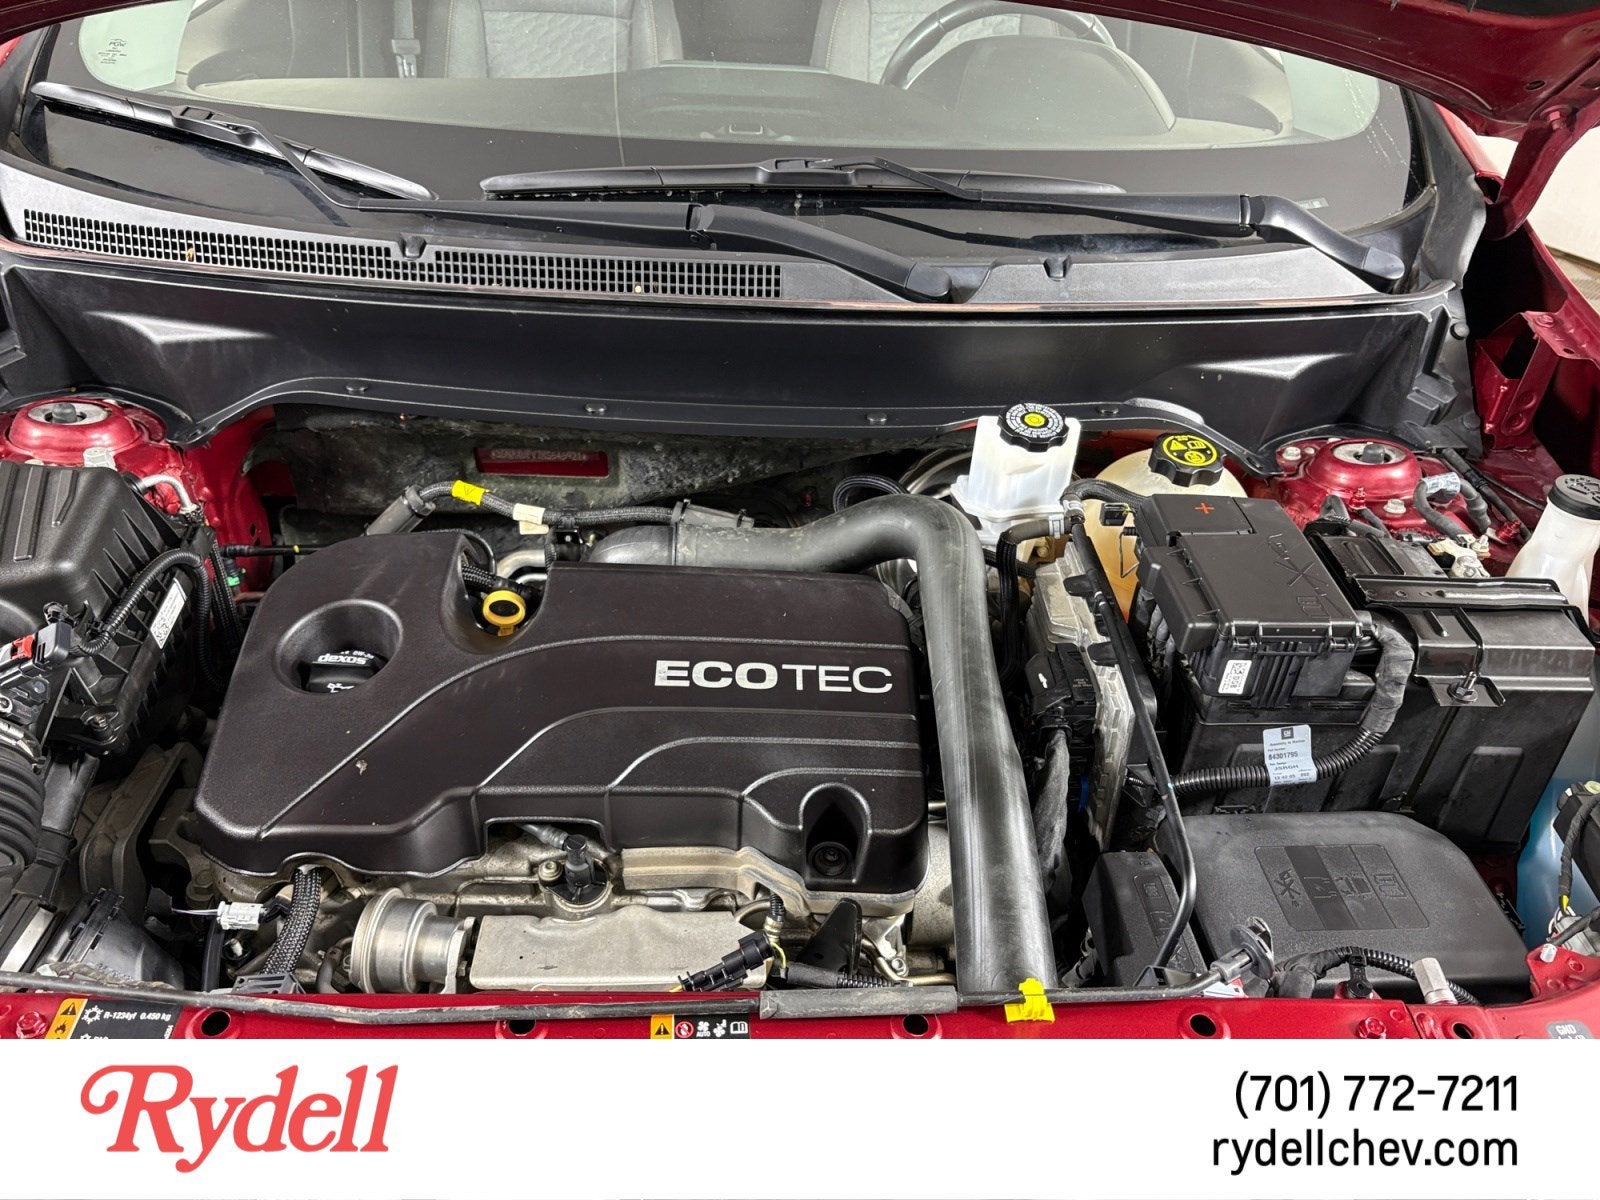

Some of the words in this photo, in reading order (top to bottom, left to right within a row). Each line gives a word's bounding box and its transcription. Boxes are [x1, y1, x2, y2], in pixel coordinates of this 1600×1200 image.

[317, 653, 369, 665] dexos
[654, 660, 893, 694] ECOTEC
[103, 1011, 137, 1020] R-1234yf
[140, 1012, 161, 1020] 0.450
[161, 1013, 171, 1022] kg
[696, 1030, 711, 1038] AUTO
[1555, 1024, 1577, 1035] GND
